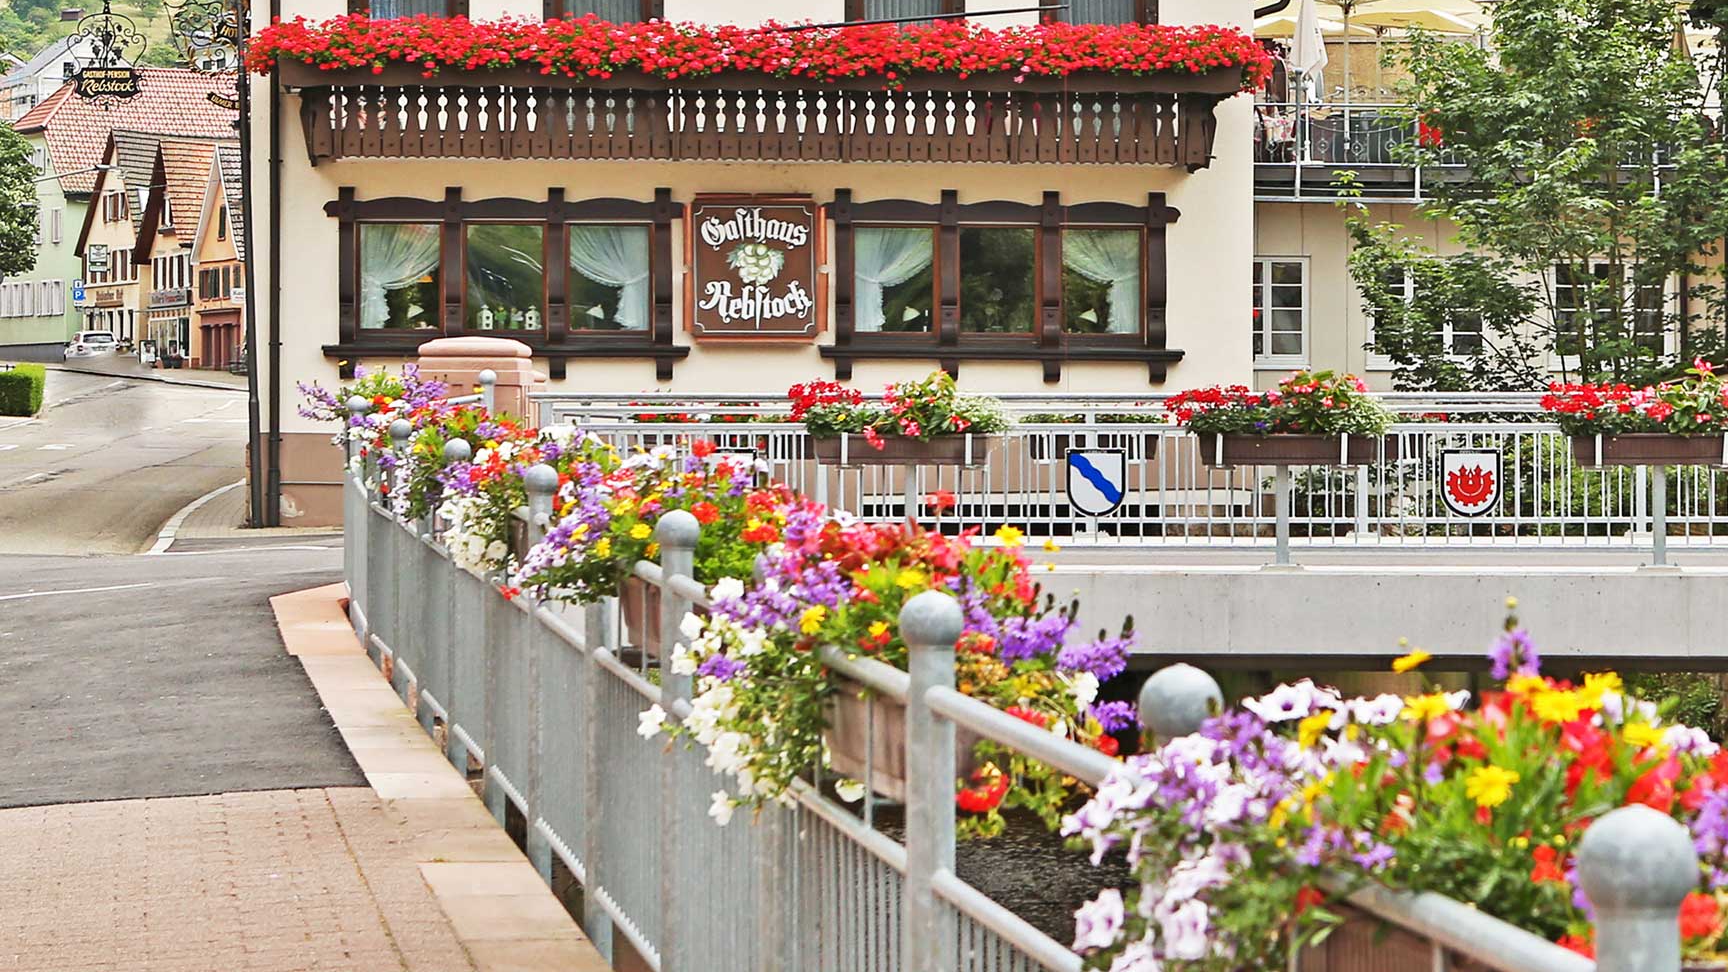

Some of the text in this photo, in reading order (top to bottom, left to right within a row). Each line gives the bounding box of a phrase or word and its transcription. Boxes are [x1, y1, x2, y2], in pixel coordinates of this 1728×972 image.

[81, 78, 135, 96] Rebstock
[701, 207, 809, 251] Gasthaus
[698, 280, 813, 330] Rebstock
